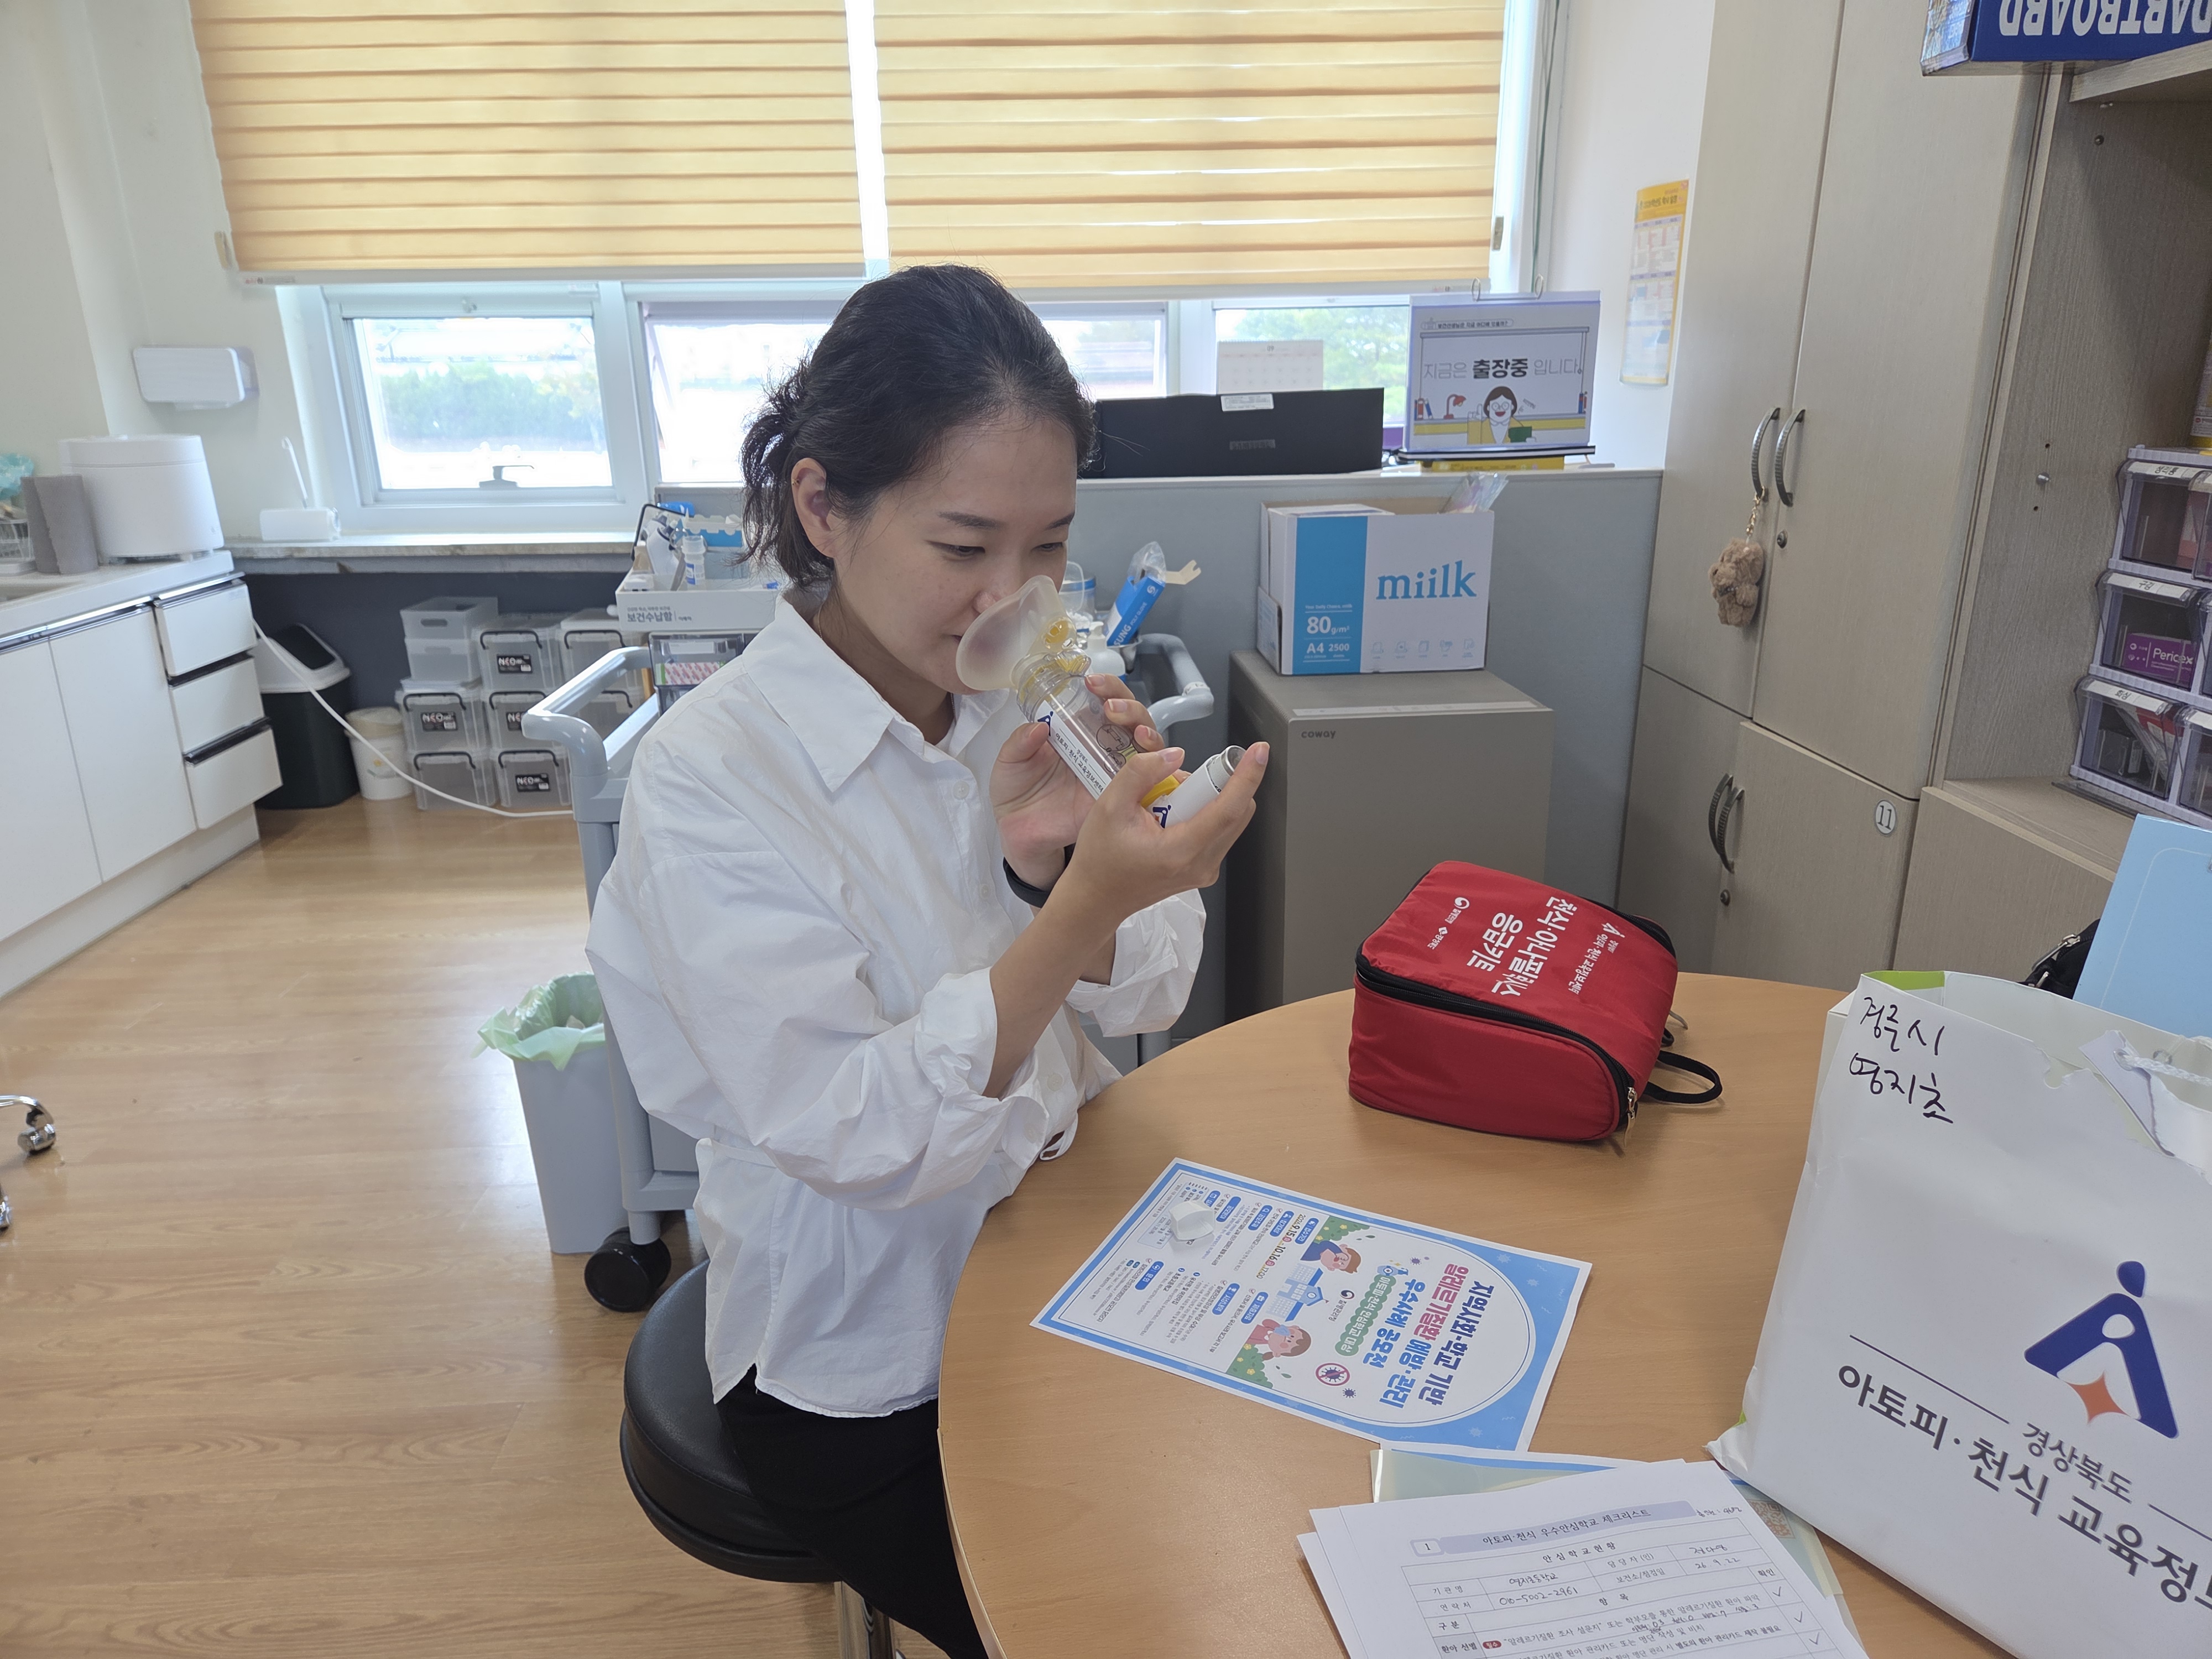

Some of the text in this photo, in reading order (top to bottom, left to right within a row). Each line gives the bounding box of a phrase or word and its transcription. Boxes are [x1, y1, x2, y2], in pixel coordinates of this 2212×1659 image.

[1423, 362, 1467, 379] 지금은
[1473, 358, 1528, 379] 출장중
[1375, 560, 1477, 601] miilk
[627, 612, 672, 623] 보건수납함
[1114, 602, 1147, 646] SUNG POLY GLOVE
[1306, 643, 1349, 654] A4 2500
[1301, 729, 1336, 739] coway
[1877, 805, 1892, 830] 11
[1465, 911, 1525, 972] 응급키트
[1491, 896, 1579, 999] 천식·아나필락시스
[1849, 1052, 1954, 1124] 영지초
[1327, 1299, 1348, 1322] 질병관리청
[1339, 1276, 1390, 1353] 아토피·천식 안심학교 대상
[1412, 1262, 1469, 1342] 알레르기질환
[1361, 1277, 1427, 1369] 우수사례 공모전
[1416, 1370, 1454, 1406] 기반
[1838, 1365, 2050, 1514] 아토피·천식
[2021, 1422, 2133, 1503] 경상북도
[1483, 1530, 1537, 1546] 아토피·천식
[1541, 1517, 1599, 1537] 우수안심학교
[1603, 1509, 1651, 1524] 체크리스트
[1758, 1568, 1776, 1577] 확인
[1558, 1629, 1574, 1637] 조사
[1608, 1620, 1623, 1628] 또는
[1626, 1611, 1657, 1625] 학부모를
[1660, 1608, 1676, 1618] 통한
[1678, 1600, 1723, 1614] 알레르기질환
[1725, 1597, 1741, 1606] 환아
[1744, 1594, 1760, 1603] 파악
[1585, 1642, 1618, 1653] 관리카드
[1620, 1639, 1637, 1647] 또는
[1639, 1634, 1656, 1644] 명단
[1658, 1630, 1674, 1639] 작성
[1688, 1624, 1705, 1632] 비치
[1649, 1646, 1664, 1655] 관리
[1667, 1642, 1674, 1651] 시
[1675, 1639, 1697, 1649] 별도의
[1714, 1631, 1743, 1642] 관리카드
